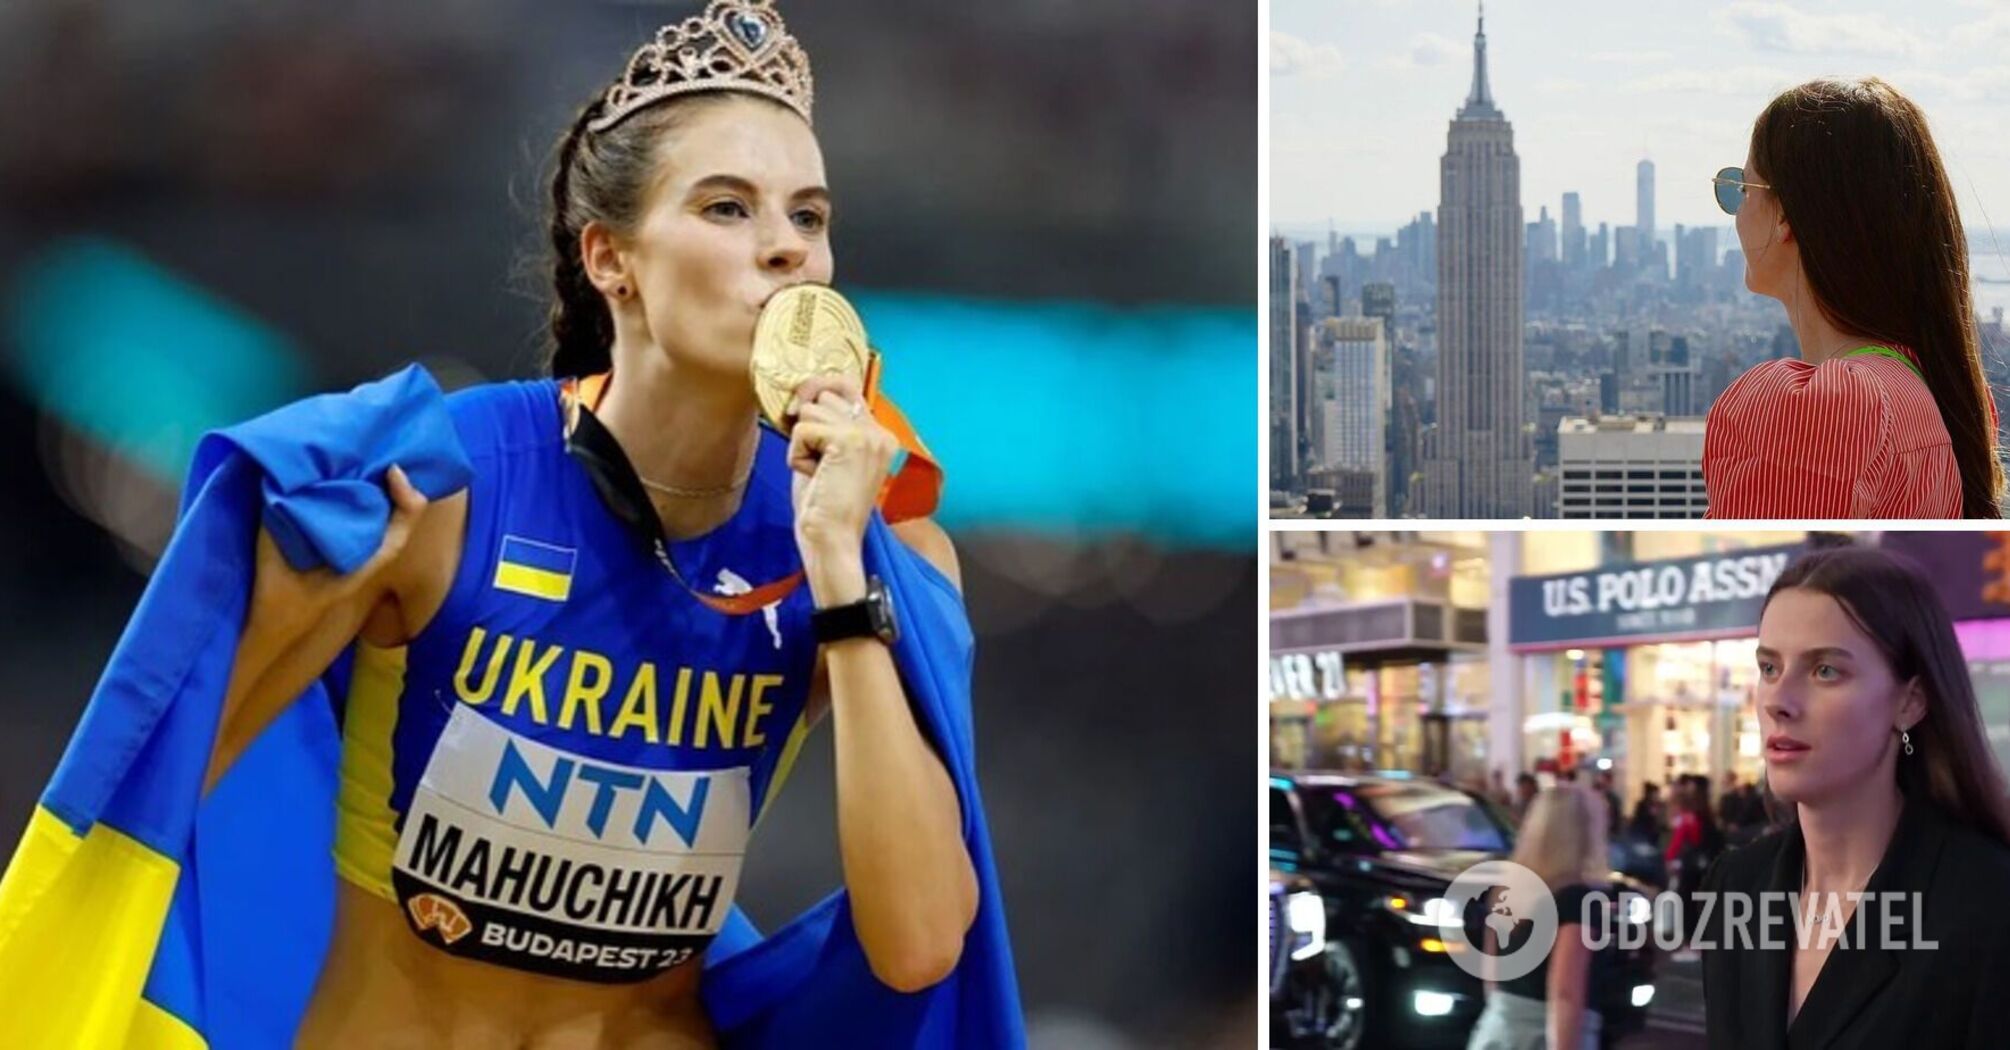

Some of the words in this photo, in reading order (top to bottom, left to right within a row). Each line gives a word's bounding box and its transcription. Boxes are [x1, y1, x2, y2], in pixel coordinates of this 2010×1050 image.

[1543, 577, 1592, 617] U.S.
[1597, 566, 1686, 612] POLO
[454, 627, 784, 749] UKRAINE
[489, 739, 711, 849] NTN
[408, 814, 723, 931] MAHUCHIKH
[481, 922, 658, 969] BUDAPEST
